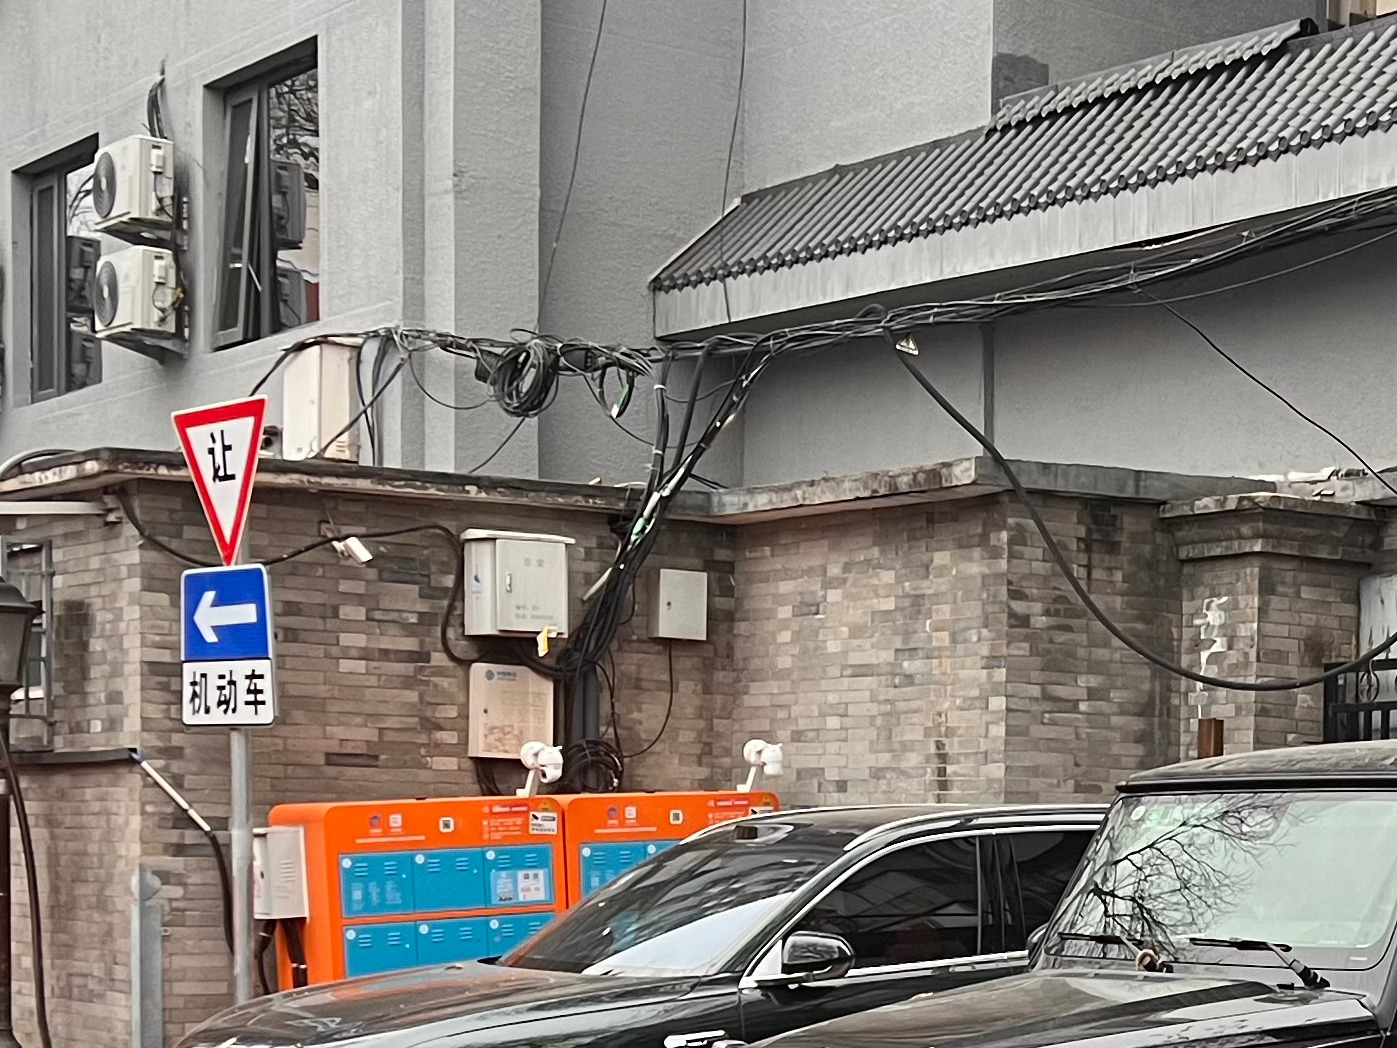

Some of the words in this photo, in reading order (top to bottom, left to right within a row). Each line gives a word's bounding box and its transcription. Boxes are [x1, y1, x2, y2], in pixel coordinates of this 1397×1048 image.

[207, 429, 236, 483] 让
[188, 668, 267, 716] 机动车
